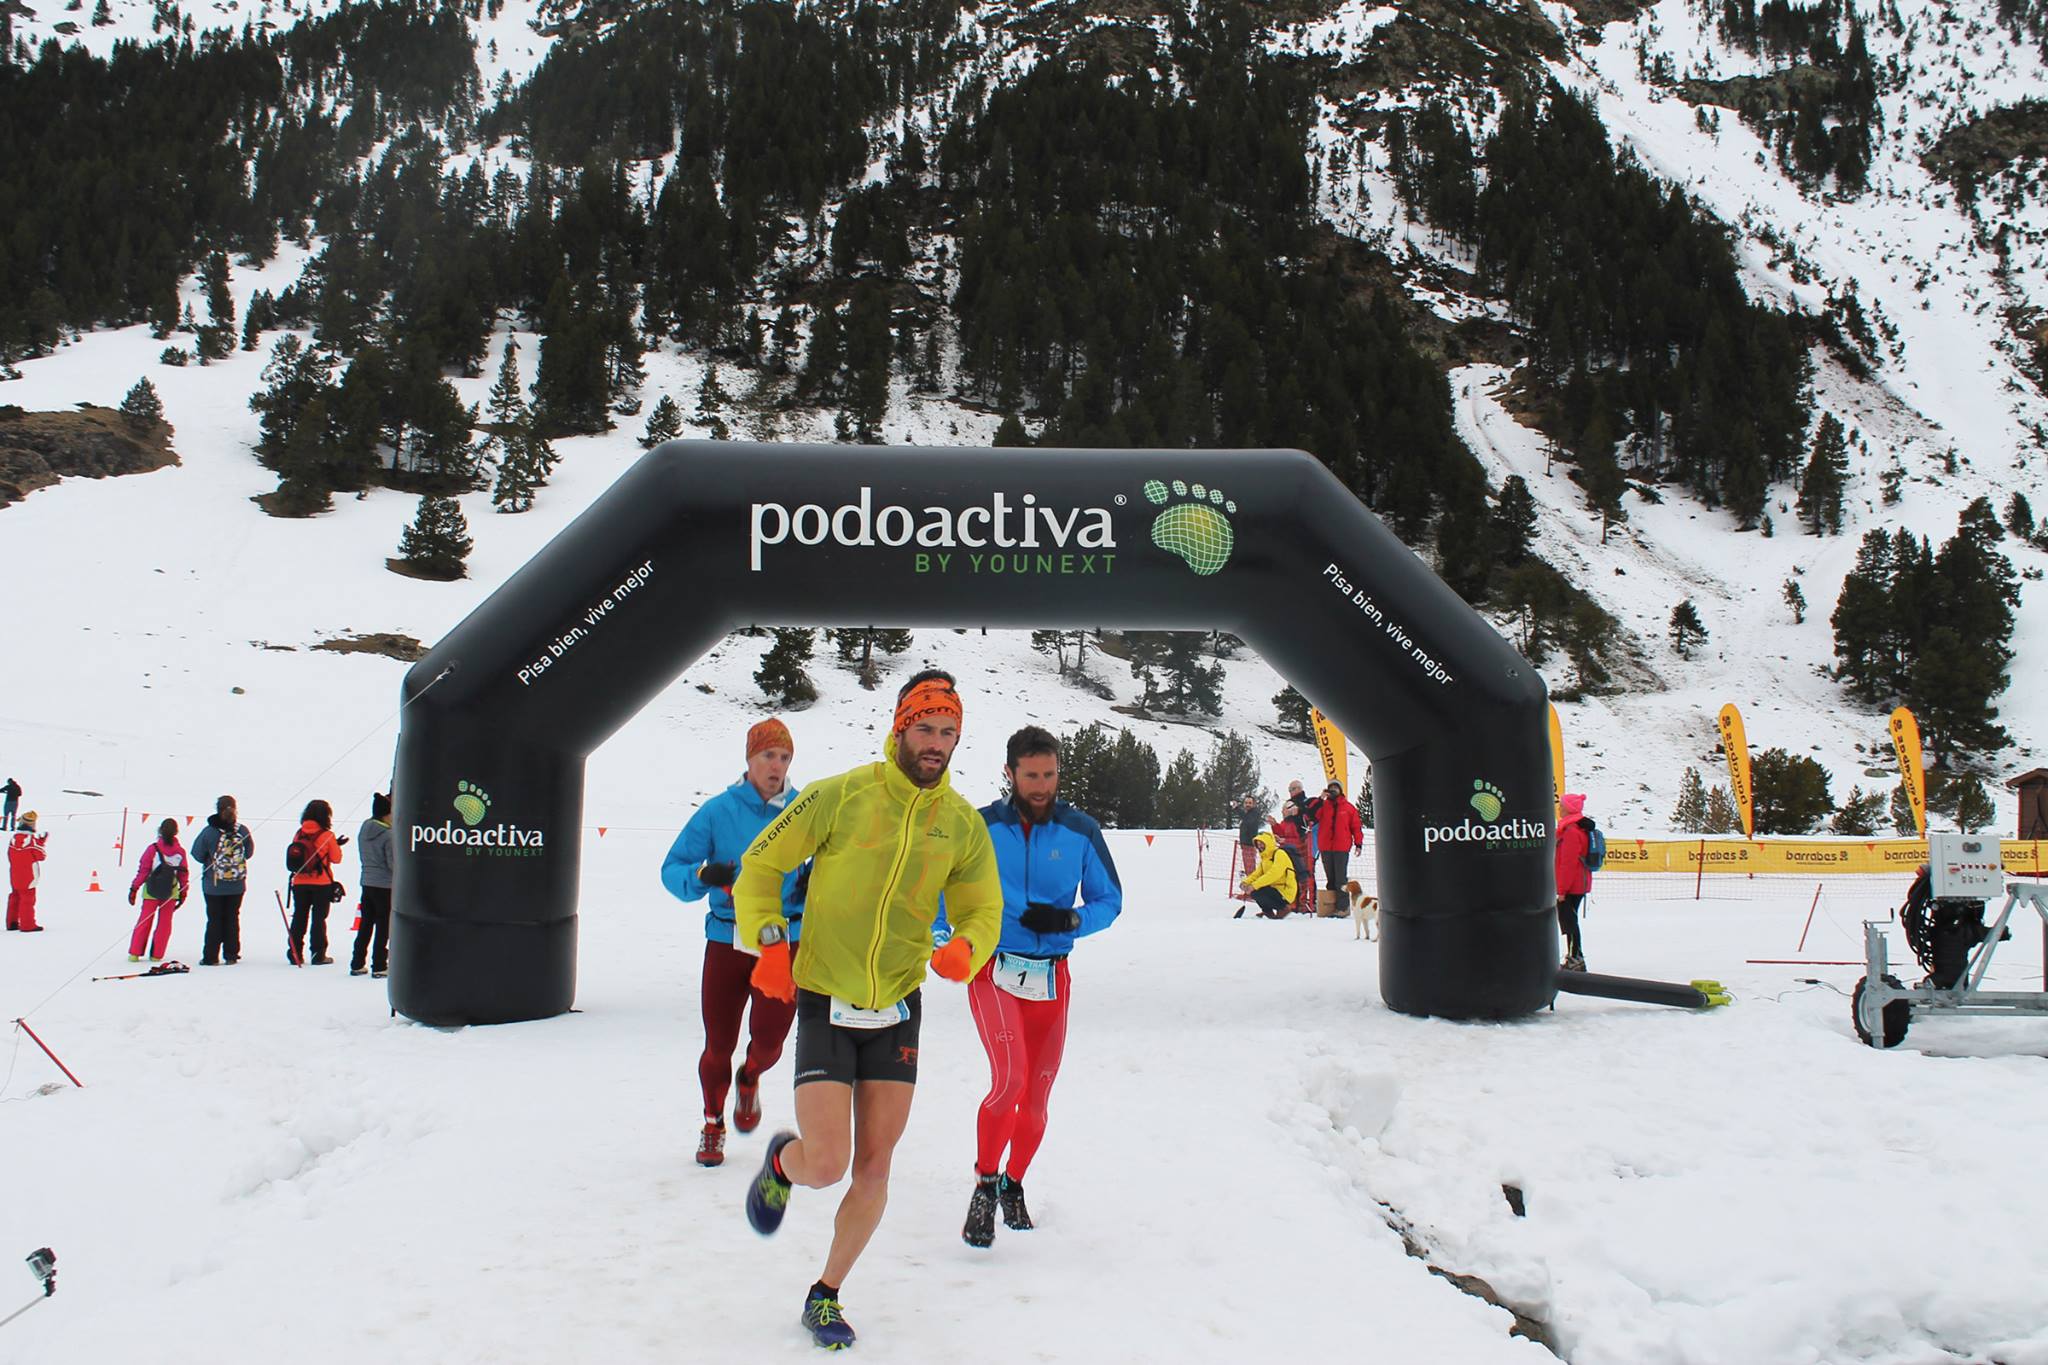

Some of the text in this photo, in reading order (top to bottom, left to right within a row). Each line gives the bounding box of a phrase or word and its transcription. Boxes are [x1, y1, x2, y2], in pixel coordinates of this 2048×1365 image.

[915, 554, 1117, 574] BY YOUNEXT
[517, 560, 654, 685] Pisa bien, vive mejor
[1323, 563, 1454, 685] Pisa bien, vive mejor
[411, 820, 544, 852] podoactiva
[1424, 818, 1546, 853] podoactiva
[465, 847, 544, 857] BY YOUNEXT
[1688, 849, 1737, 861] barrabes
[1785, 850, 1838, 861] barrabes
[1017, 970, 1028, 986] 1
